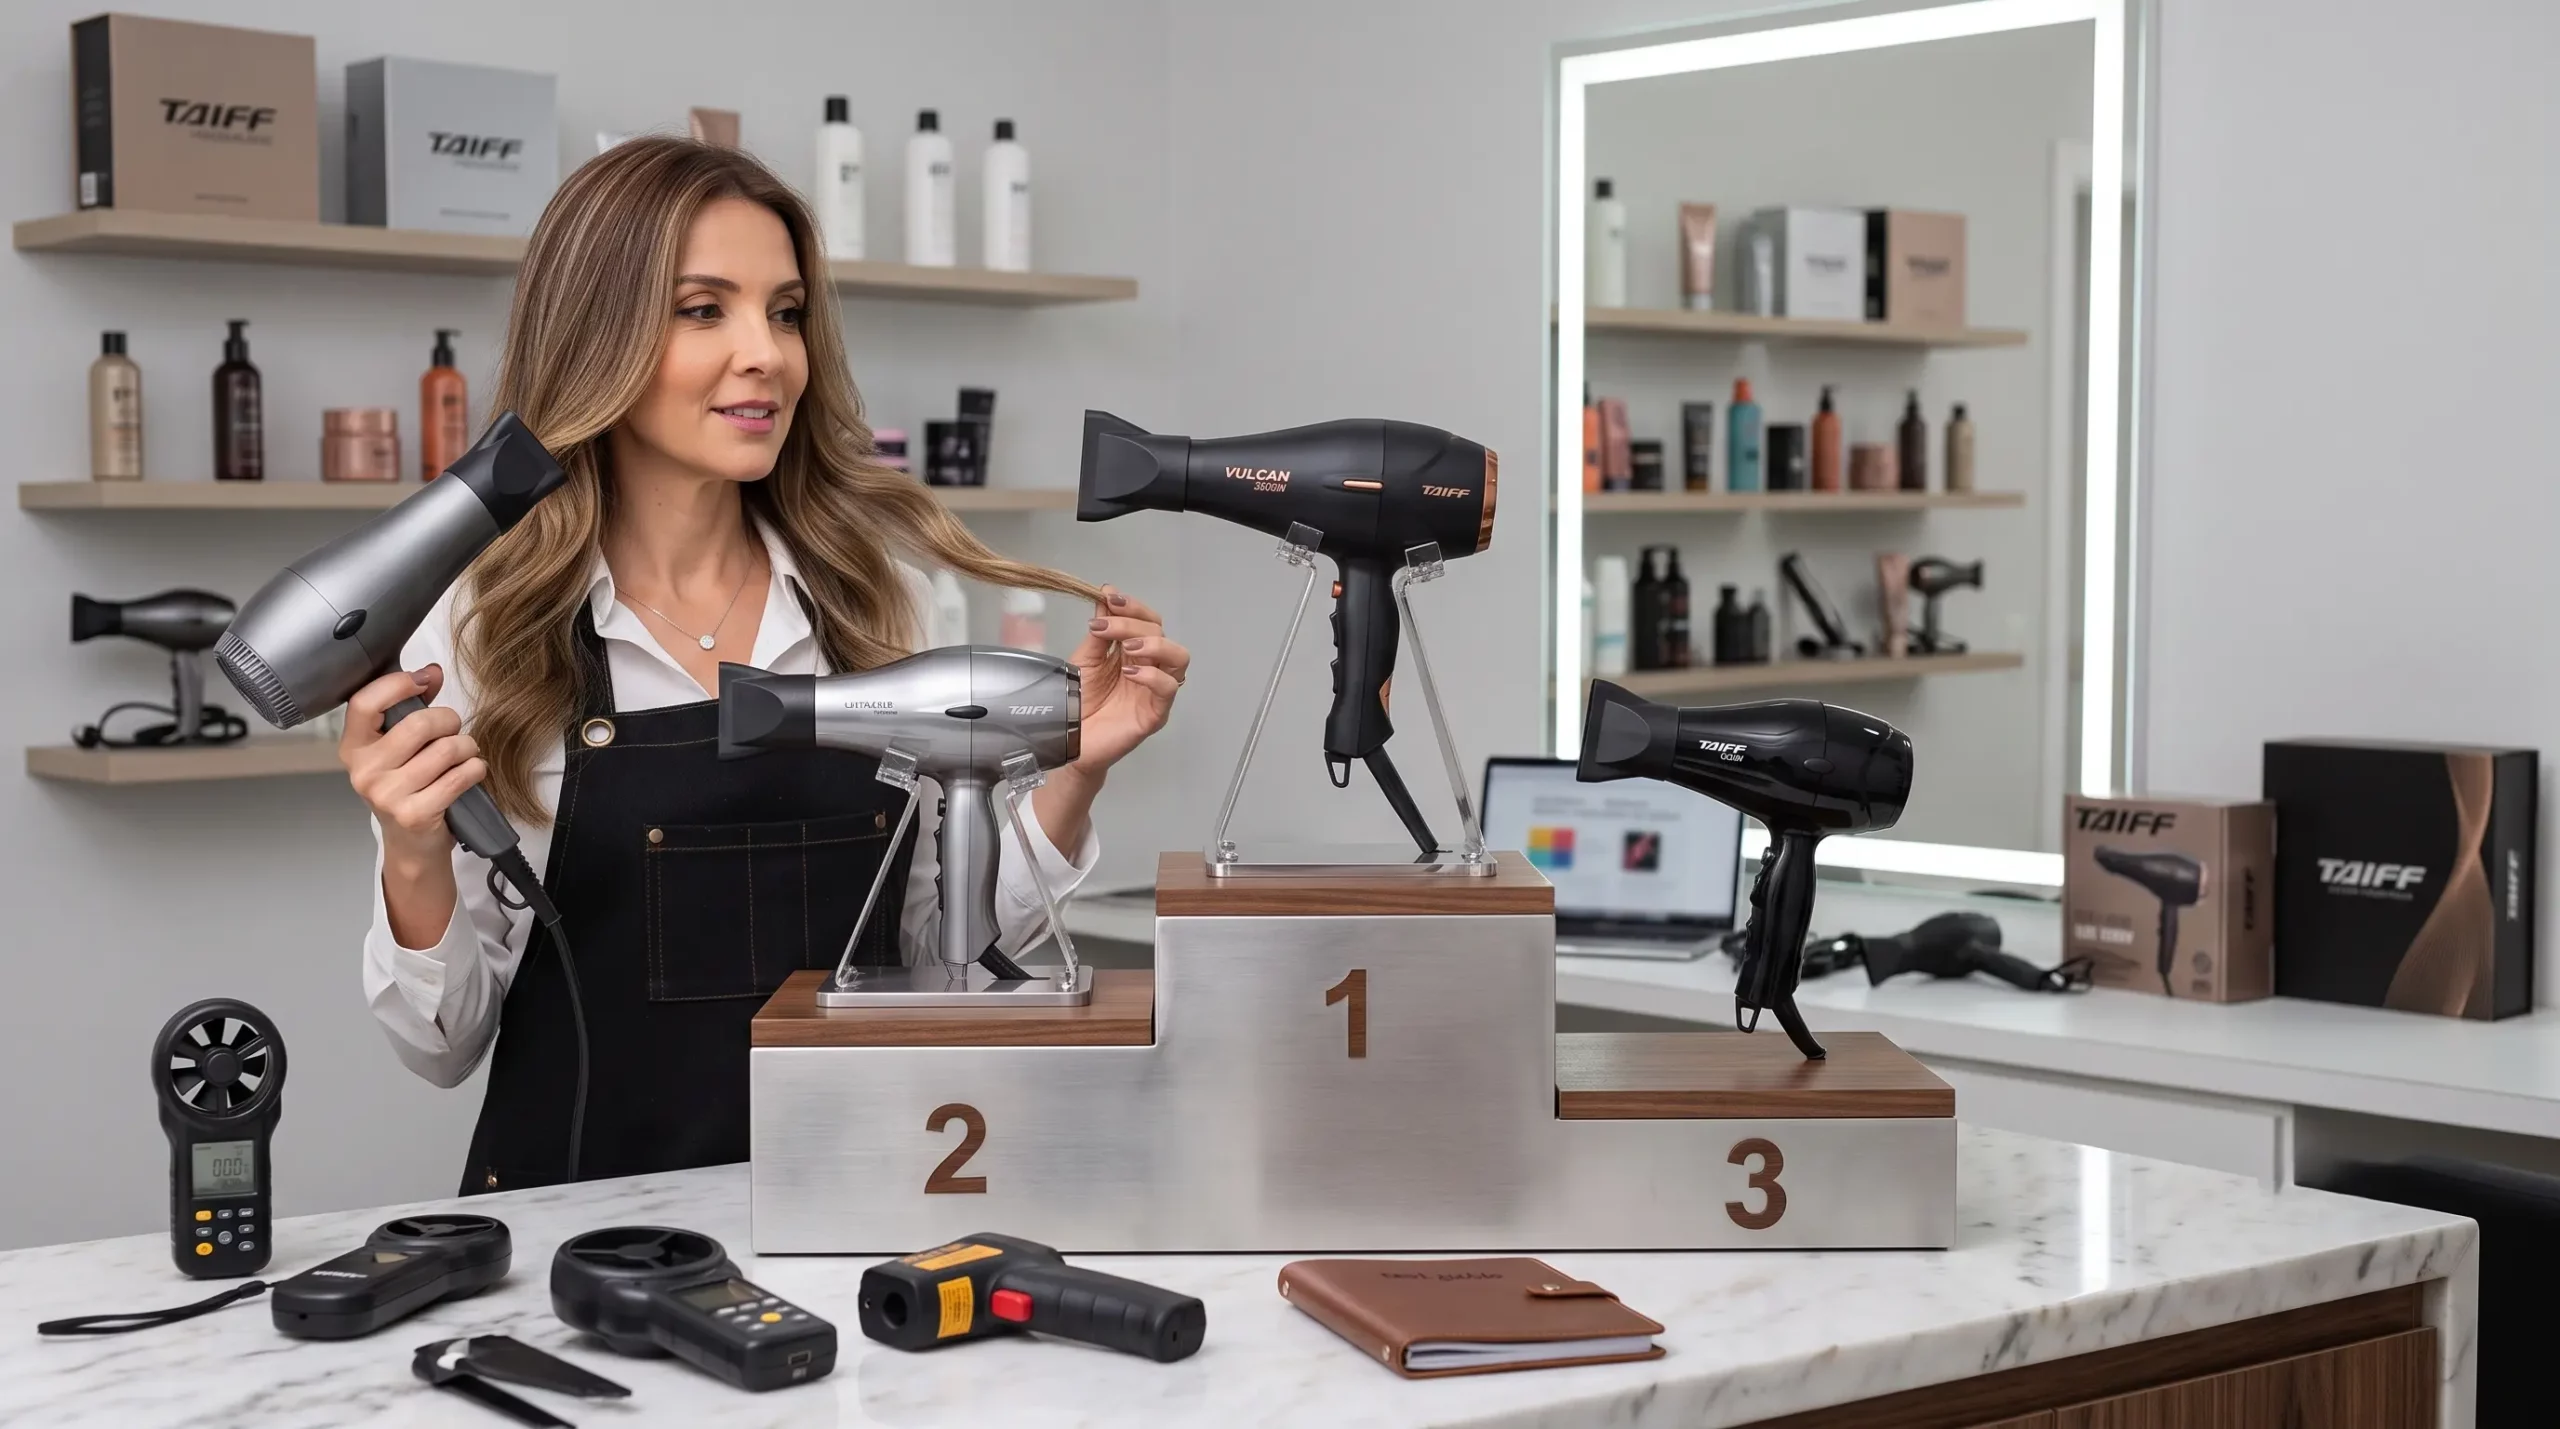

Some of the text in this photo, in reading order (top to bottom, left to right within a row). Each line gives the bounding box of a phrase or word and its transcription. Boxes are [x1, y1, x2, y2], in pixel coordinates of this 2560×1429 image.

[160, 98, 278, 132] TAIFF
[428, 131, 522, 159] TAIFF
[1225, 466, 1291, 482] VULCAN
[1422, 485, 1471, 499] TAIFF
[1008, 705, 1054, 715] TAIFF
[1699, 740, 1747, 754] TAIFF
[2074, 806, 2178, 837] TAIFF
[2317, 857, 2428, 890] TAIFF
[1326, 968, 1368, 1059] 1
[924, 1102, 987, 1195] 2
[1725, 1138, 1788, 1231] 3
